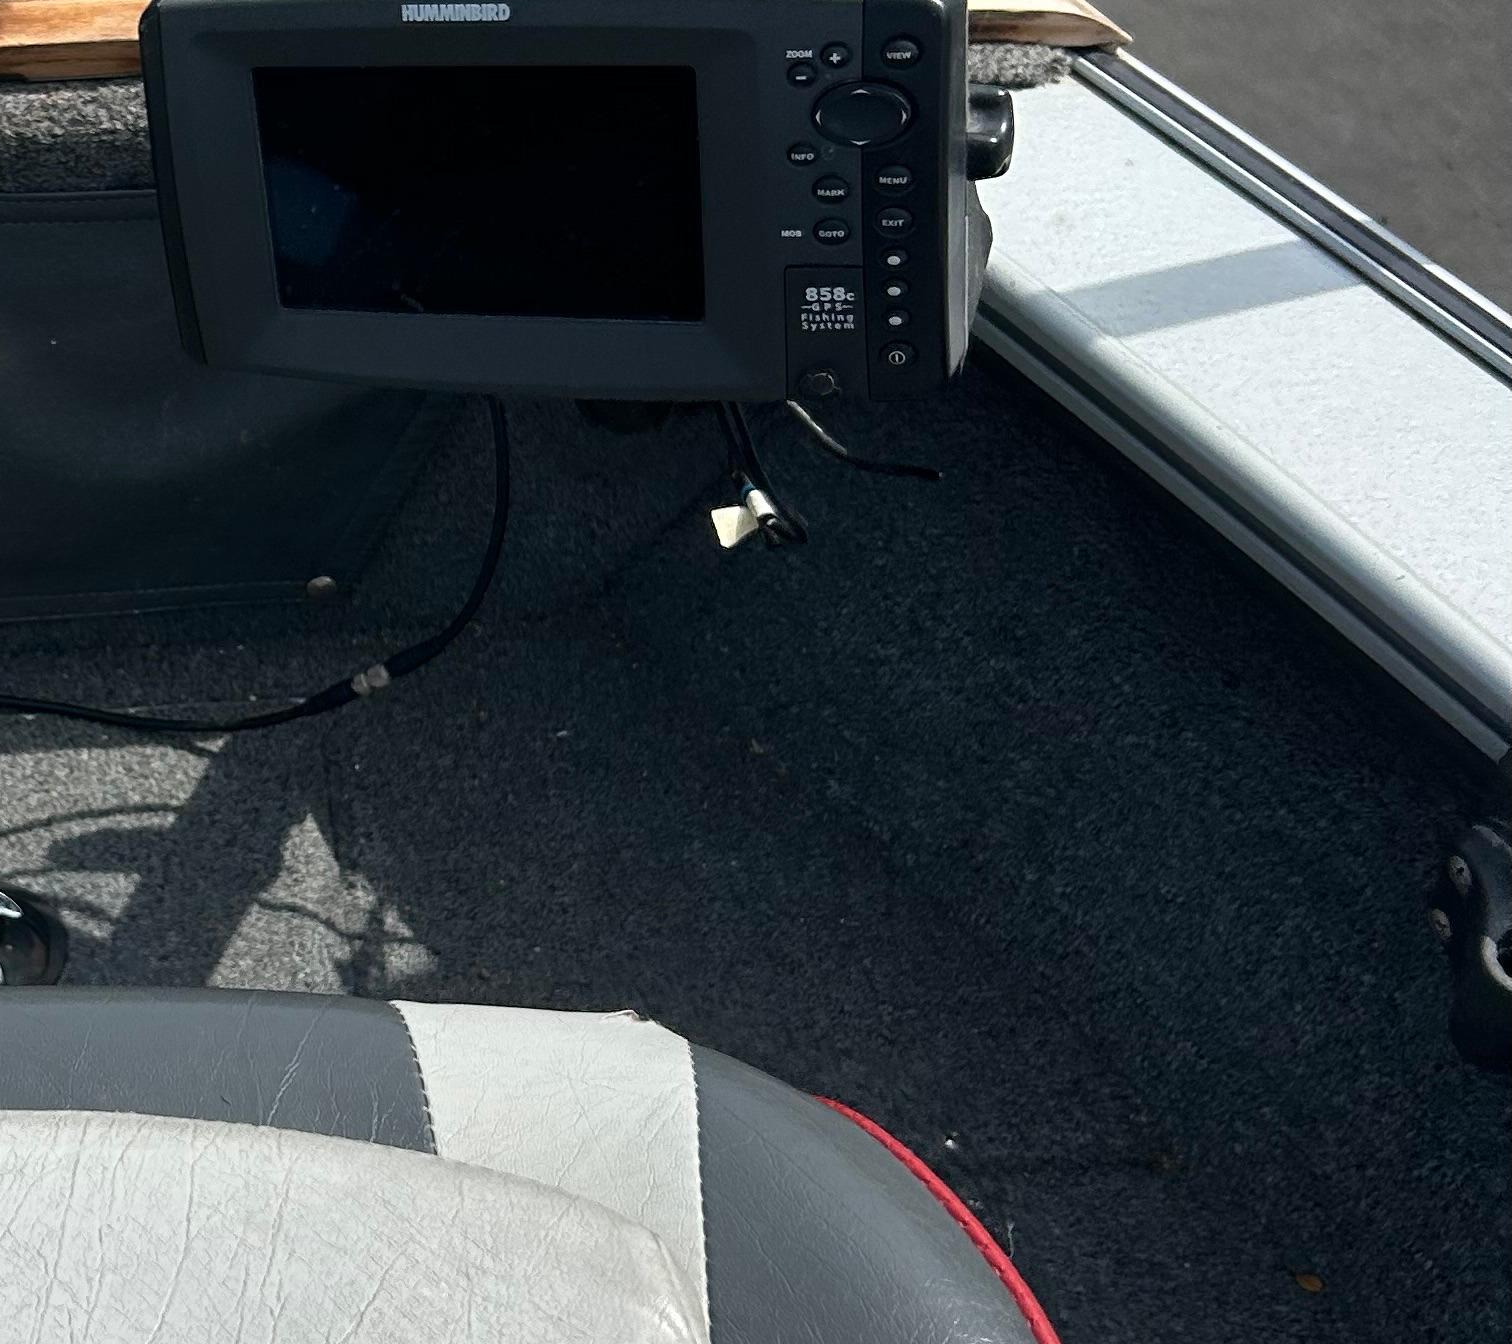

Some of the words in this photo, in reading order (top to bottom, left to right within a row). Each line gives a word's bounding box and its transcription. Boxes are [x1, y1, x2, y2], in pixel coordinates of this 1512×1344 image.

[401, 3, 511, 22] HUMMINBIRD
[786, 50, 813, 58] ZOOM
[887, 51, 911, 60] VIEW
[791, 153, 814, 161] INFO
[879, 176, 907, 185] MENU
[817, 189, 845, 197] MARK
[882, 219, 904, 227] EXIT
[819, 230, 845, 238] GOTO
[805, 287, 855, 302] 858c
[811, 303, 843, 312] GPS
[801, 313, 854, 323] Fishing
[801, 322, 855, 332] System
